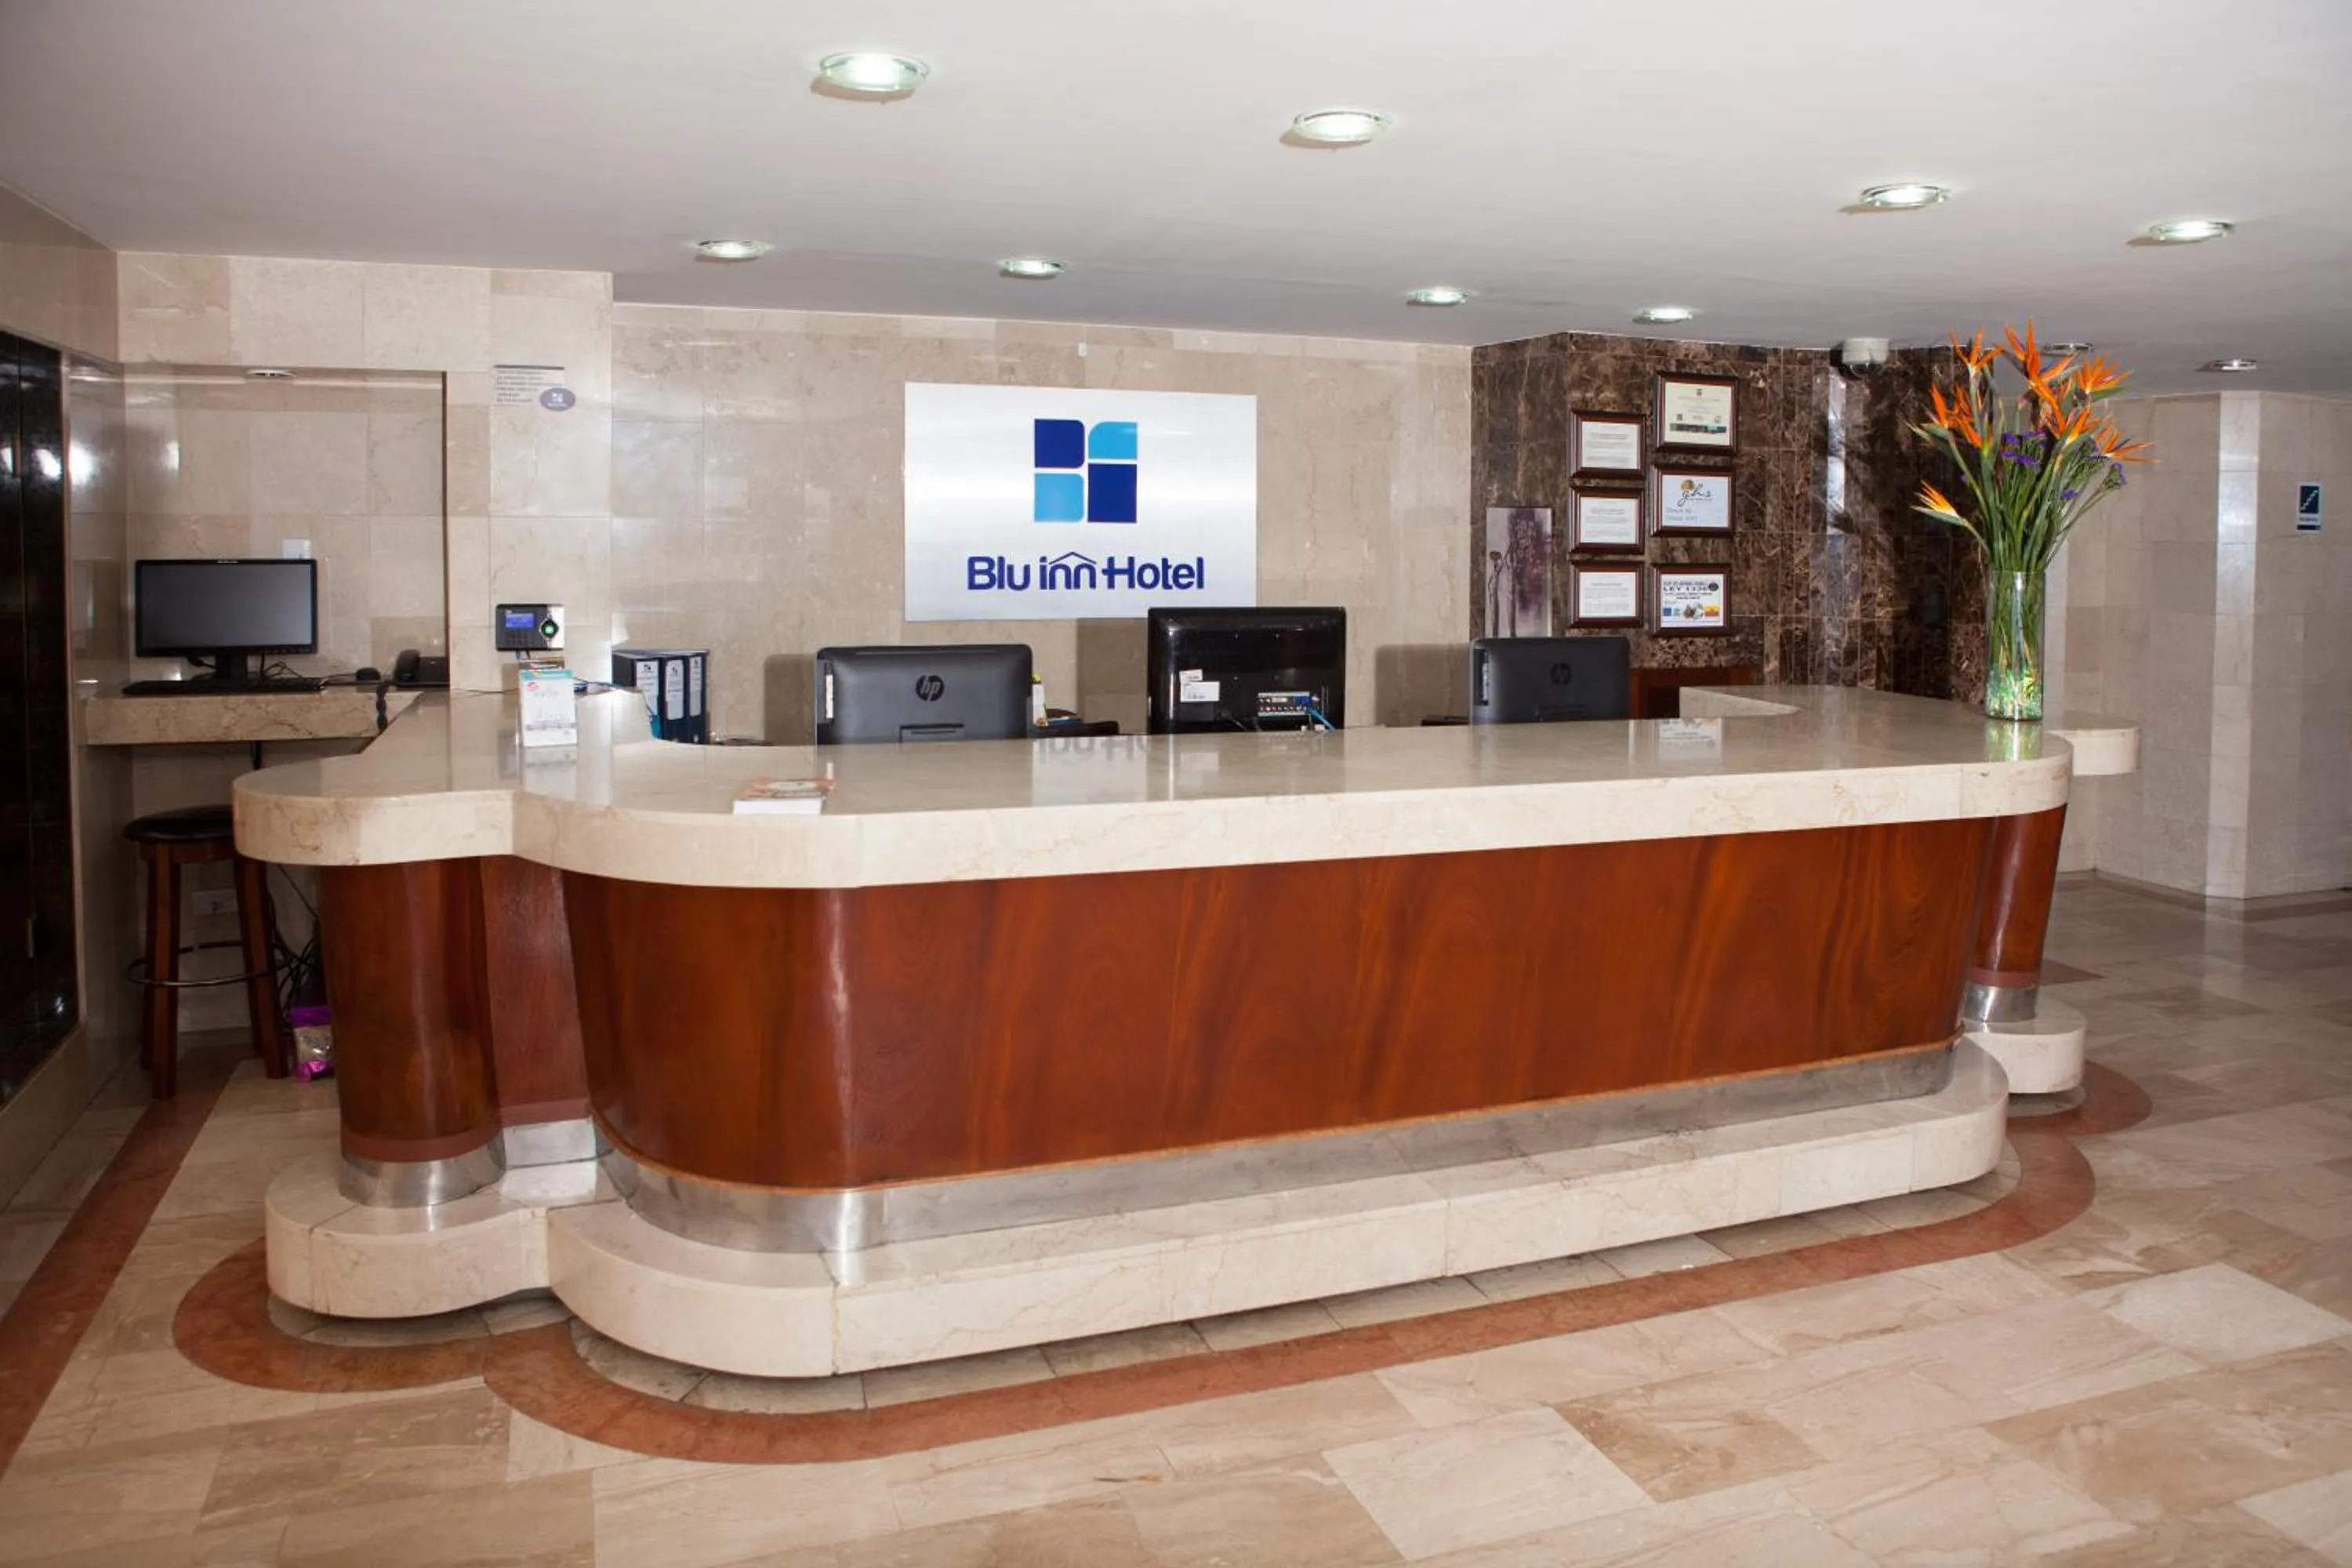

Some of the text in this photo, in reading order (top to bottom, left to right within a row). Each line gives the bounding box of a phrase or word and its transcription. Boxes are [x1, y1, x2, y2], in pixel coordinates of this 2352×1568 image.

[967, 555, 1205, 592] Blu inn Hotel
[916, 674, 945, 703] hp
